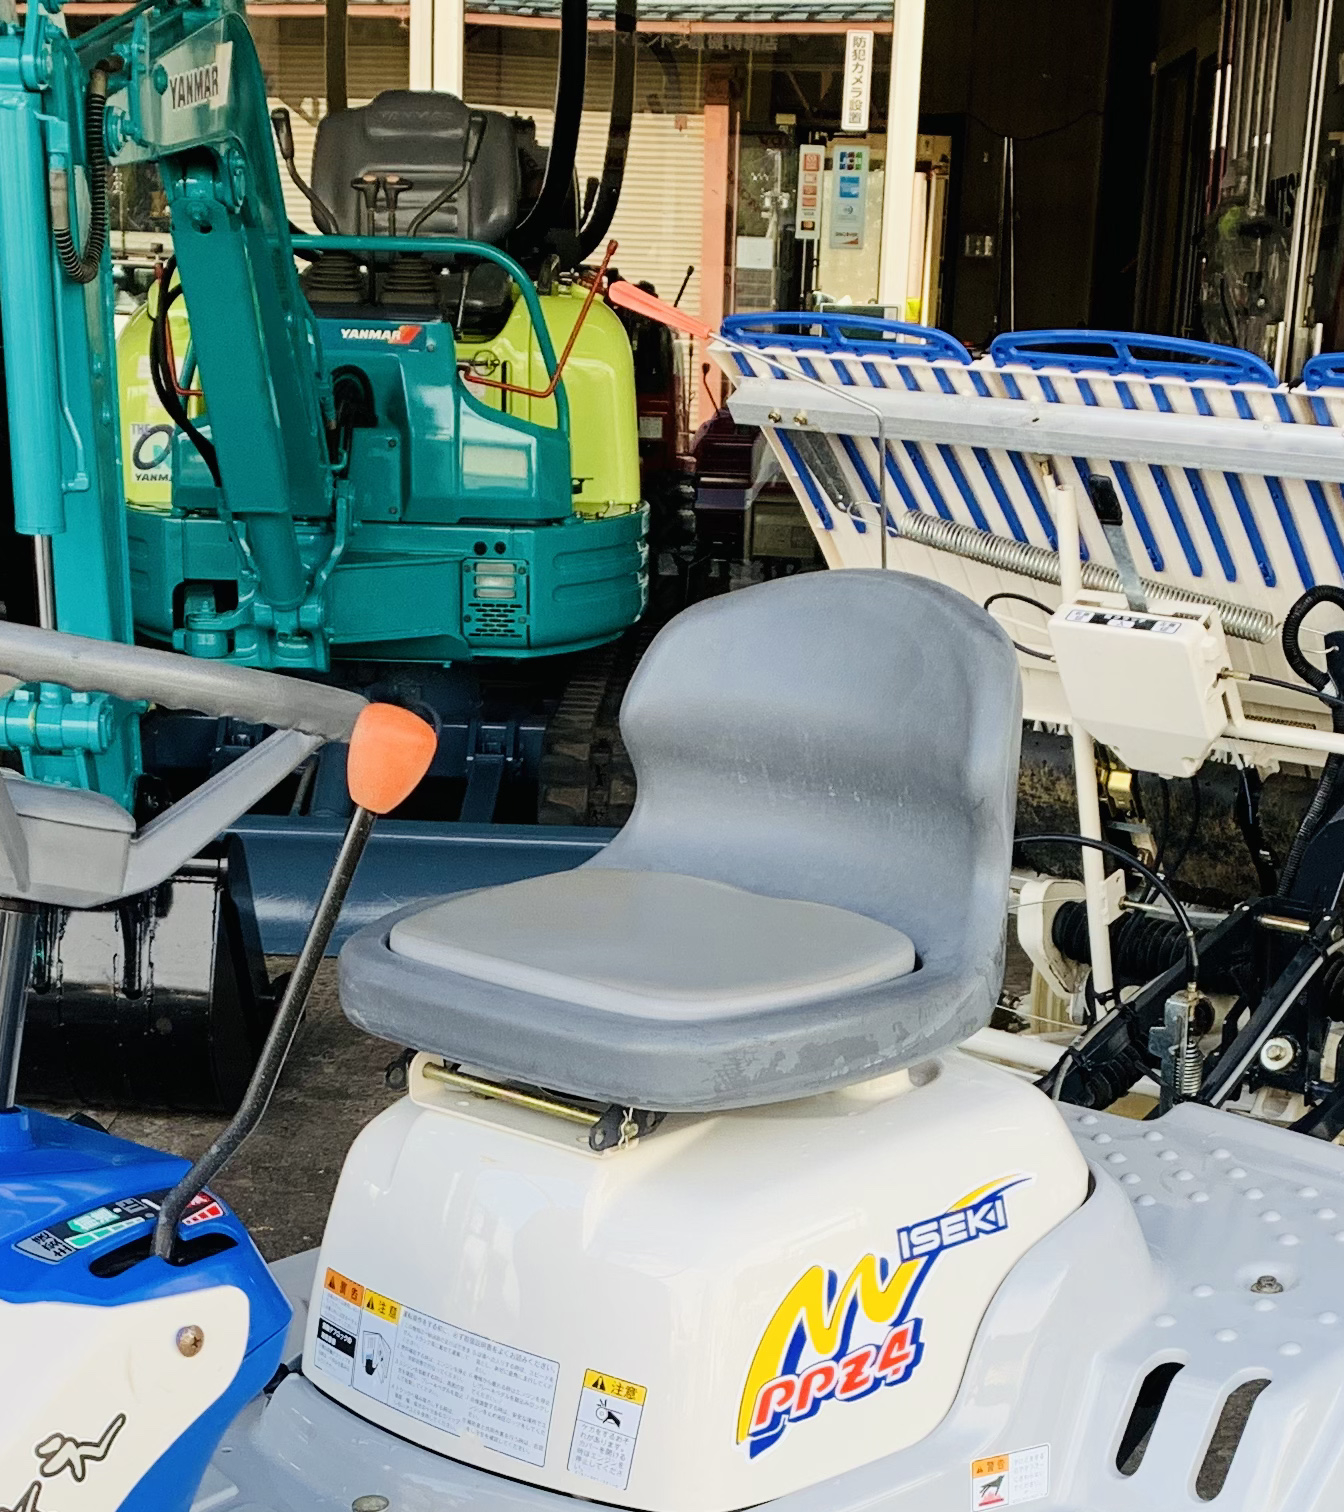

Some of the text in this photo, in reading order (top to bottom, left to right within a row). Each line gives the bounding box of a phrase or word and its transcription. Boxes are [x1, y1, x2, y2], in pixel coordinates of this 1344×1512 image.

[169, 65, 219, 110] YANMAR
[848, 35, 867, 124] 防犯カメラ設置
[340, 328, 401, 342] YANMAR
[135, 473, 172, 482] YANM
[899, 1196, 1008, 1262] ISEKI
[377, 1299, 397, 1320] 注意
[610, 1380, 637, 1401] 注意
[751, 1322, 917, 1432] PPZ4
